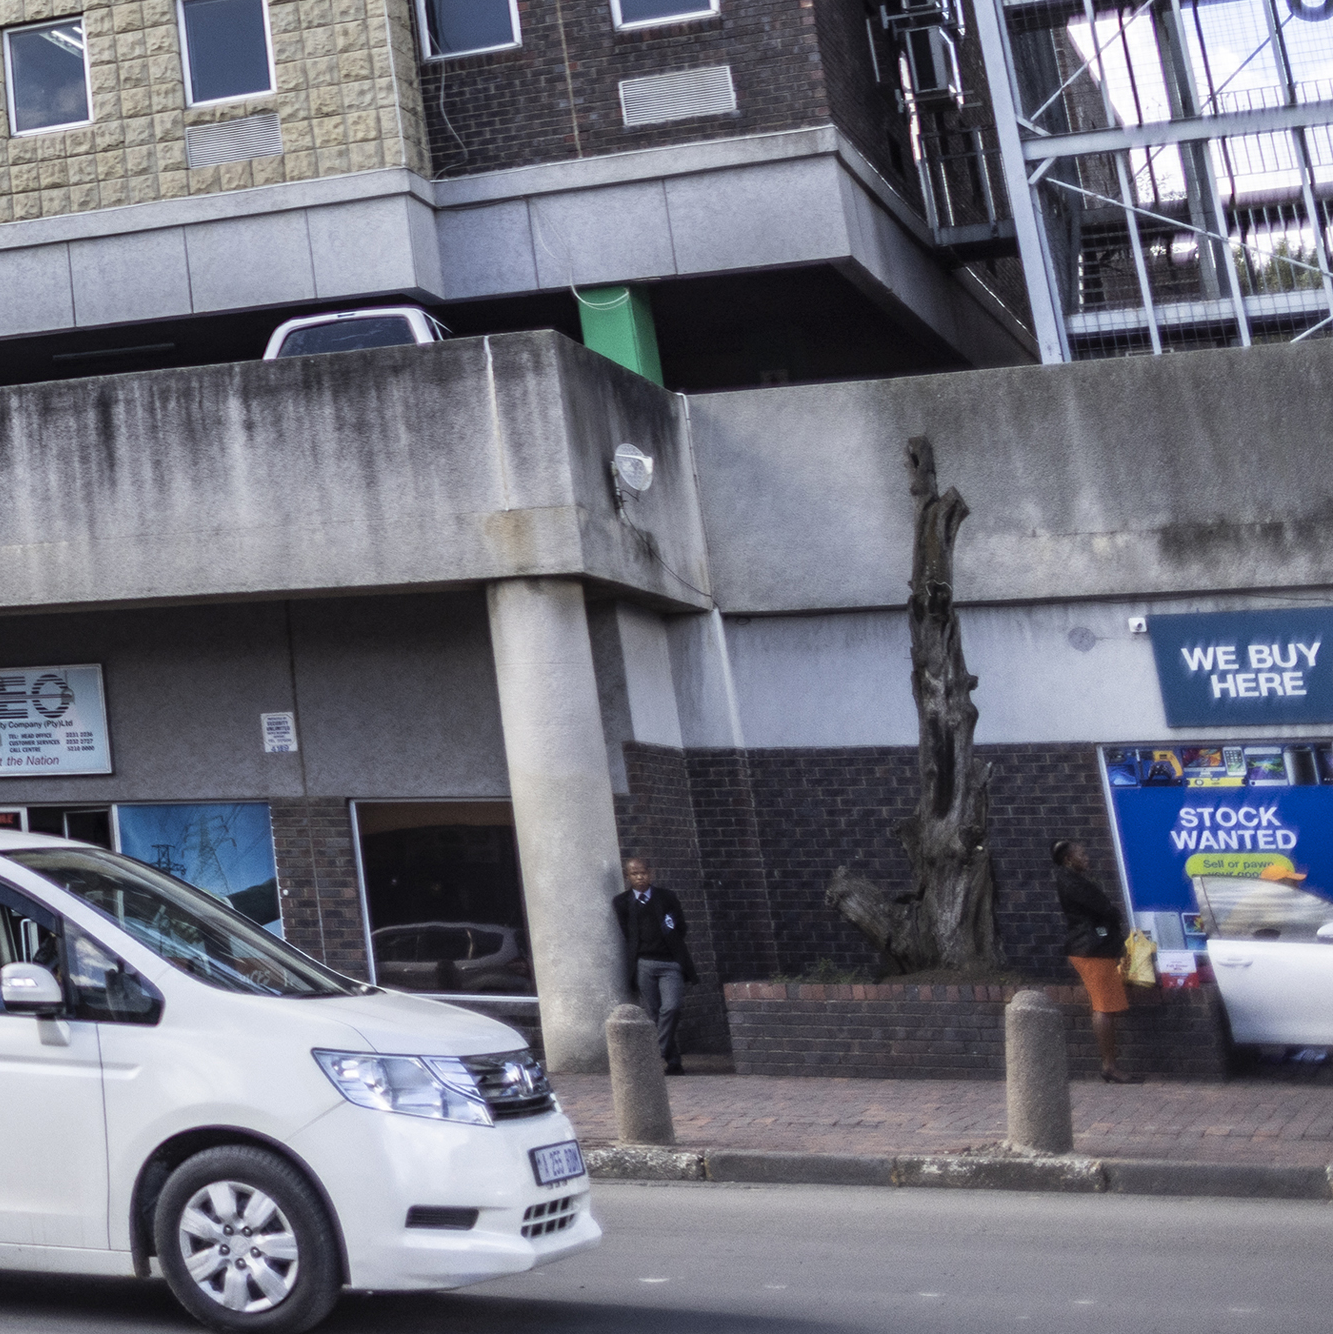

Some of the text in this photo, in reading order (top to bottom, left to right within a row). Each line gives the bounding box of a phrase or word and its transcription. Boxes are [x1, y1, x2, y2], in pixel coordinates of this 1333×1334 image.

[1181, 642, 1321, 671] WE BUY
[1211, 671, 1307, 698] HERE
[8, 721, 42, 730] Company
[7, 756, 23, 766] the
[26, 755, 60, 766] Nation
[1180, 806, 1282, 828] STOCK
[1171, 830, 1297, 850] WANTED
[1203, 859, 1224, 868] Sell
